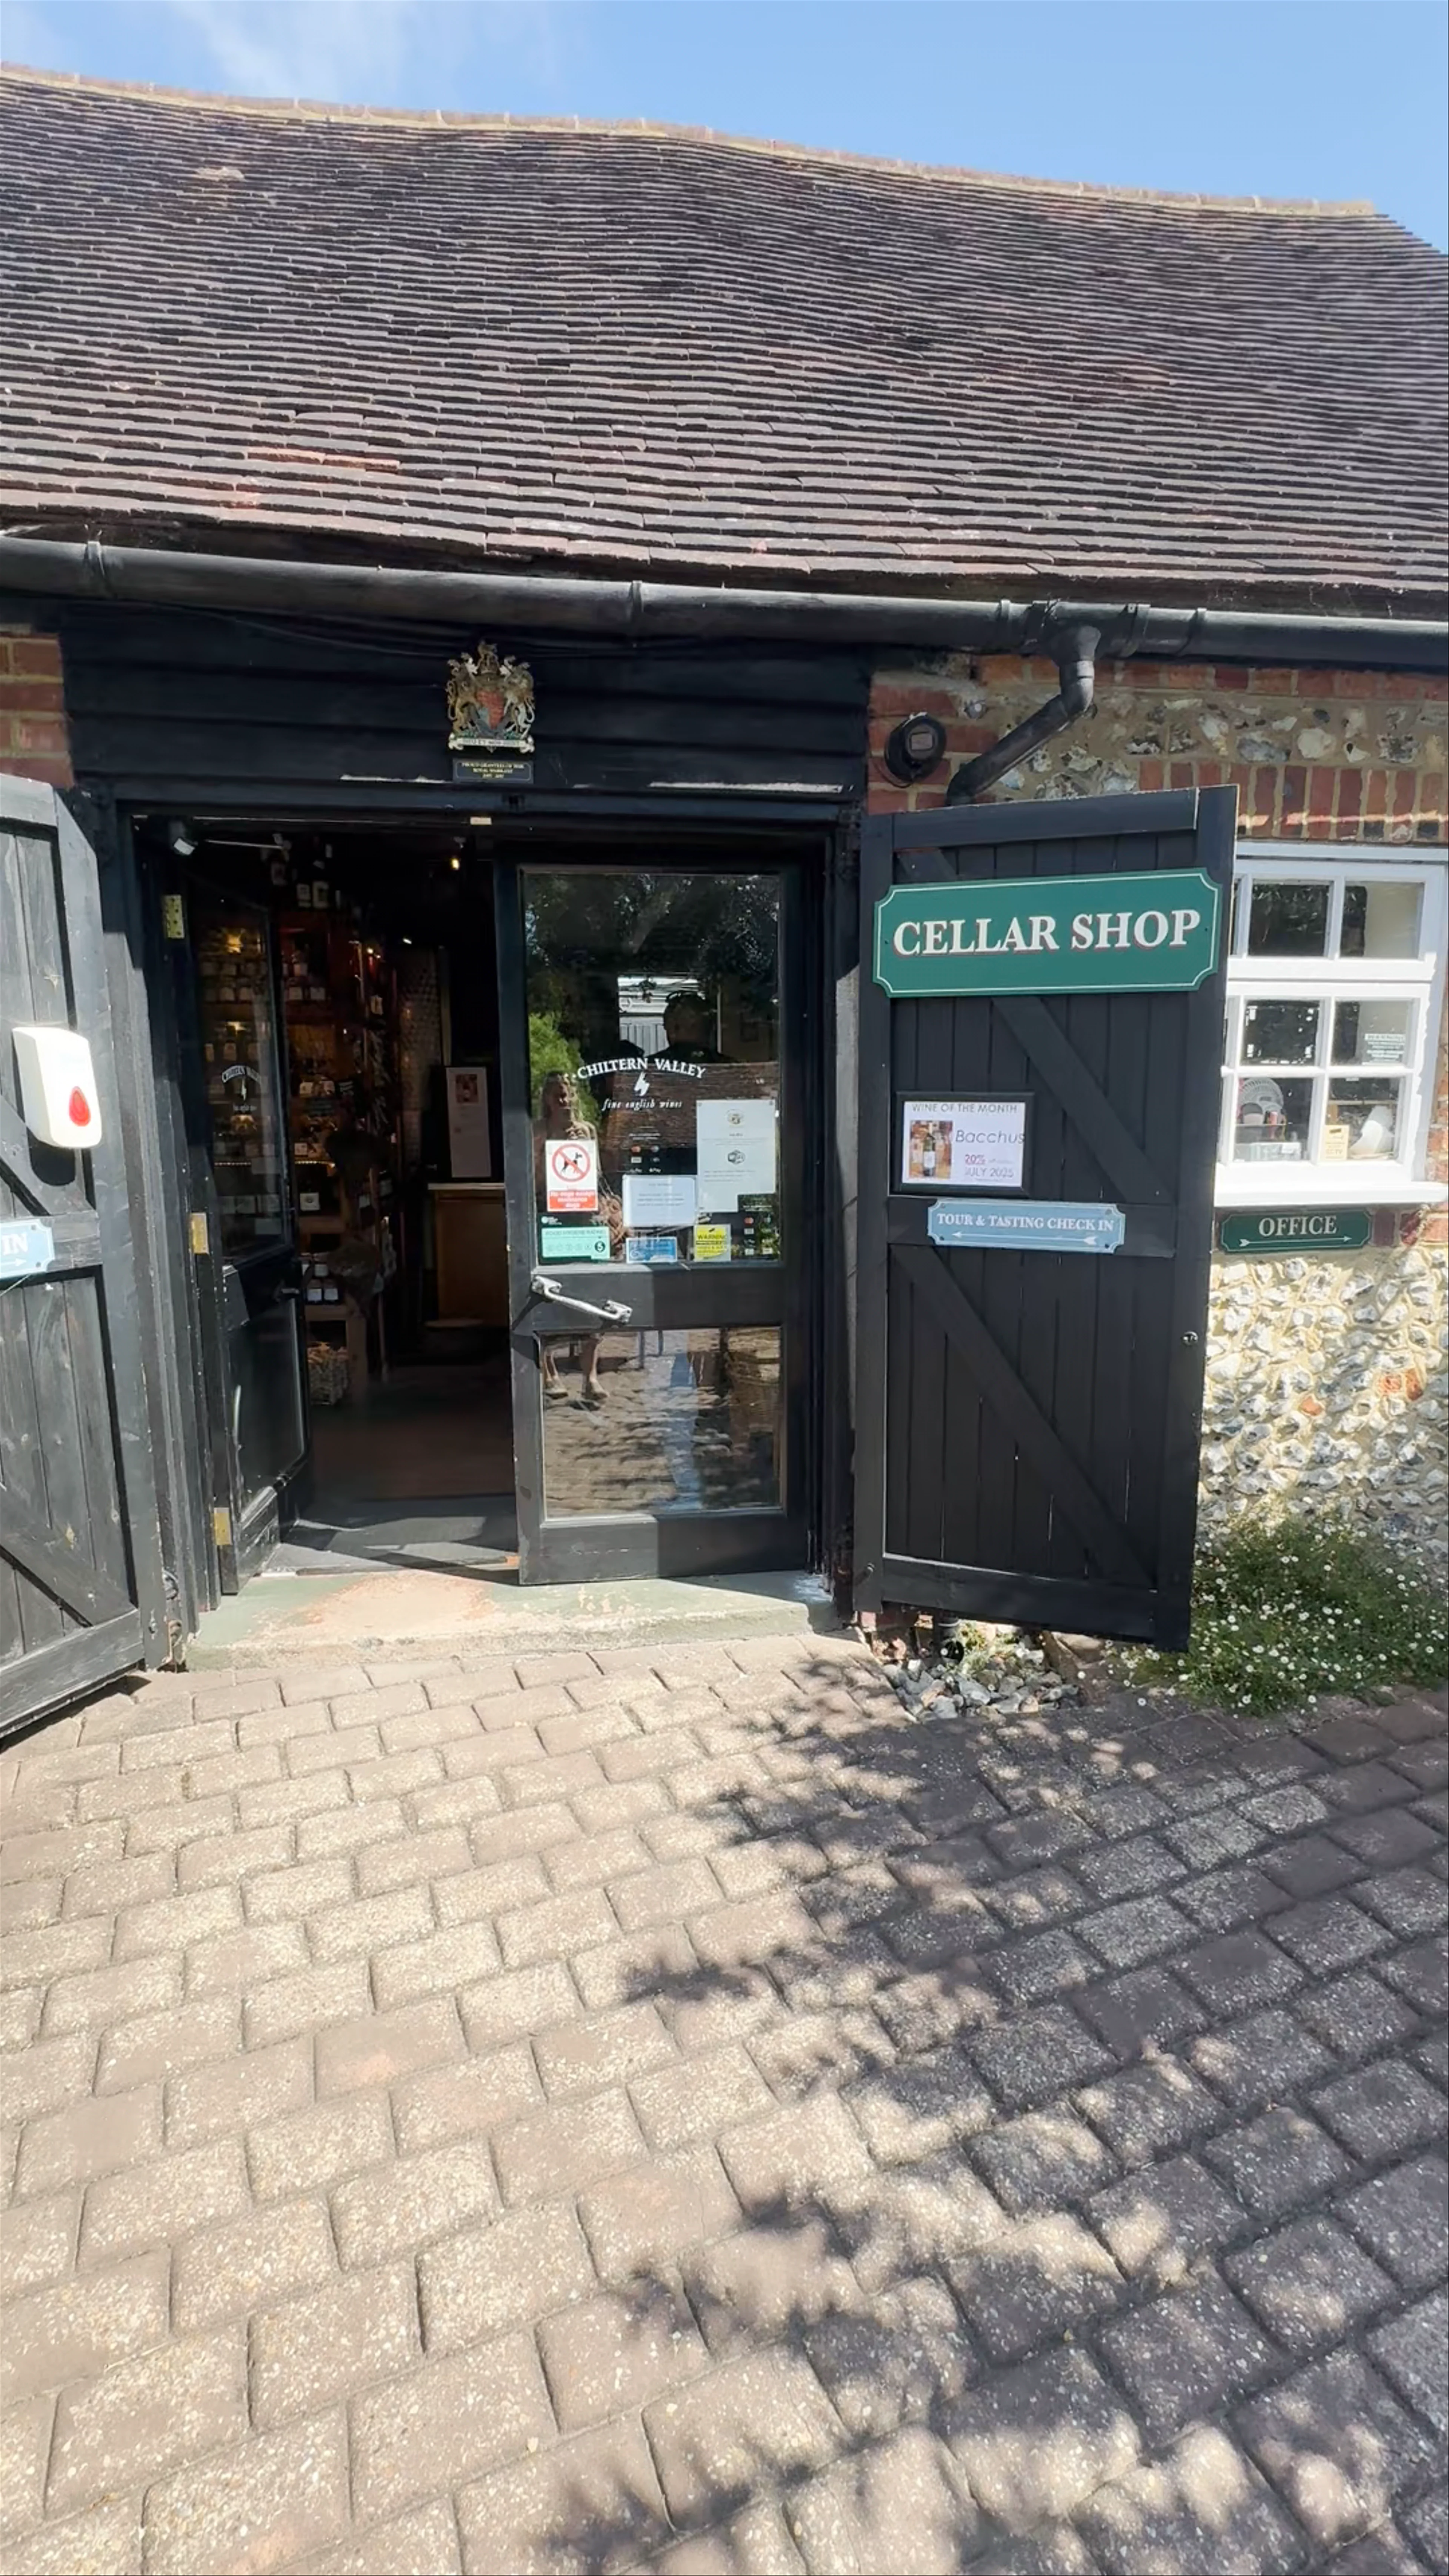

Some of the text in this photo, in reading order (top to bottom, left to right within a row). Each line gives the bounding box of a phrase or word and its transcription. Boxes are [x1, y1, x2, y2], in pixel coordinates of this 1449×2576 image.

[893, 909, 1200, 955] CELLAR SHOP
[577, 1057, 706, 1078] CHILTERN VALLEY
[602, 1098, 621, 1111] fine
[625, 1098, 655, 1110] english
[912, 1103, 1017, 1113] WINE OF THE MONTH
[955, 1130, 1025, 1144] Bacchus
[937, 1213, 1114, 1232] TOUR & TASTING CHECK IN
[1259, 1215, 1337, 1237] OFFICE
[2, 1232, 28, 1256] IN
